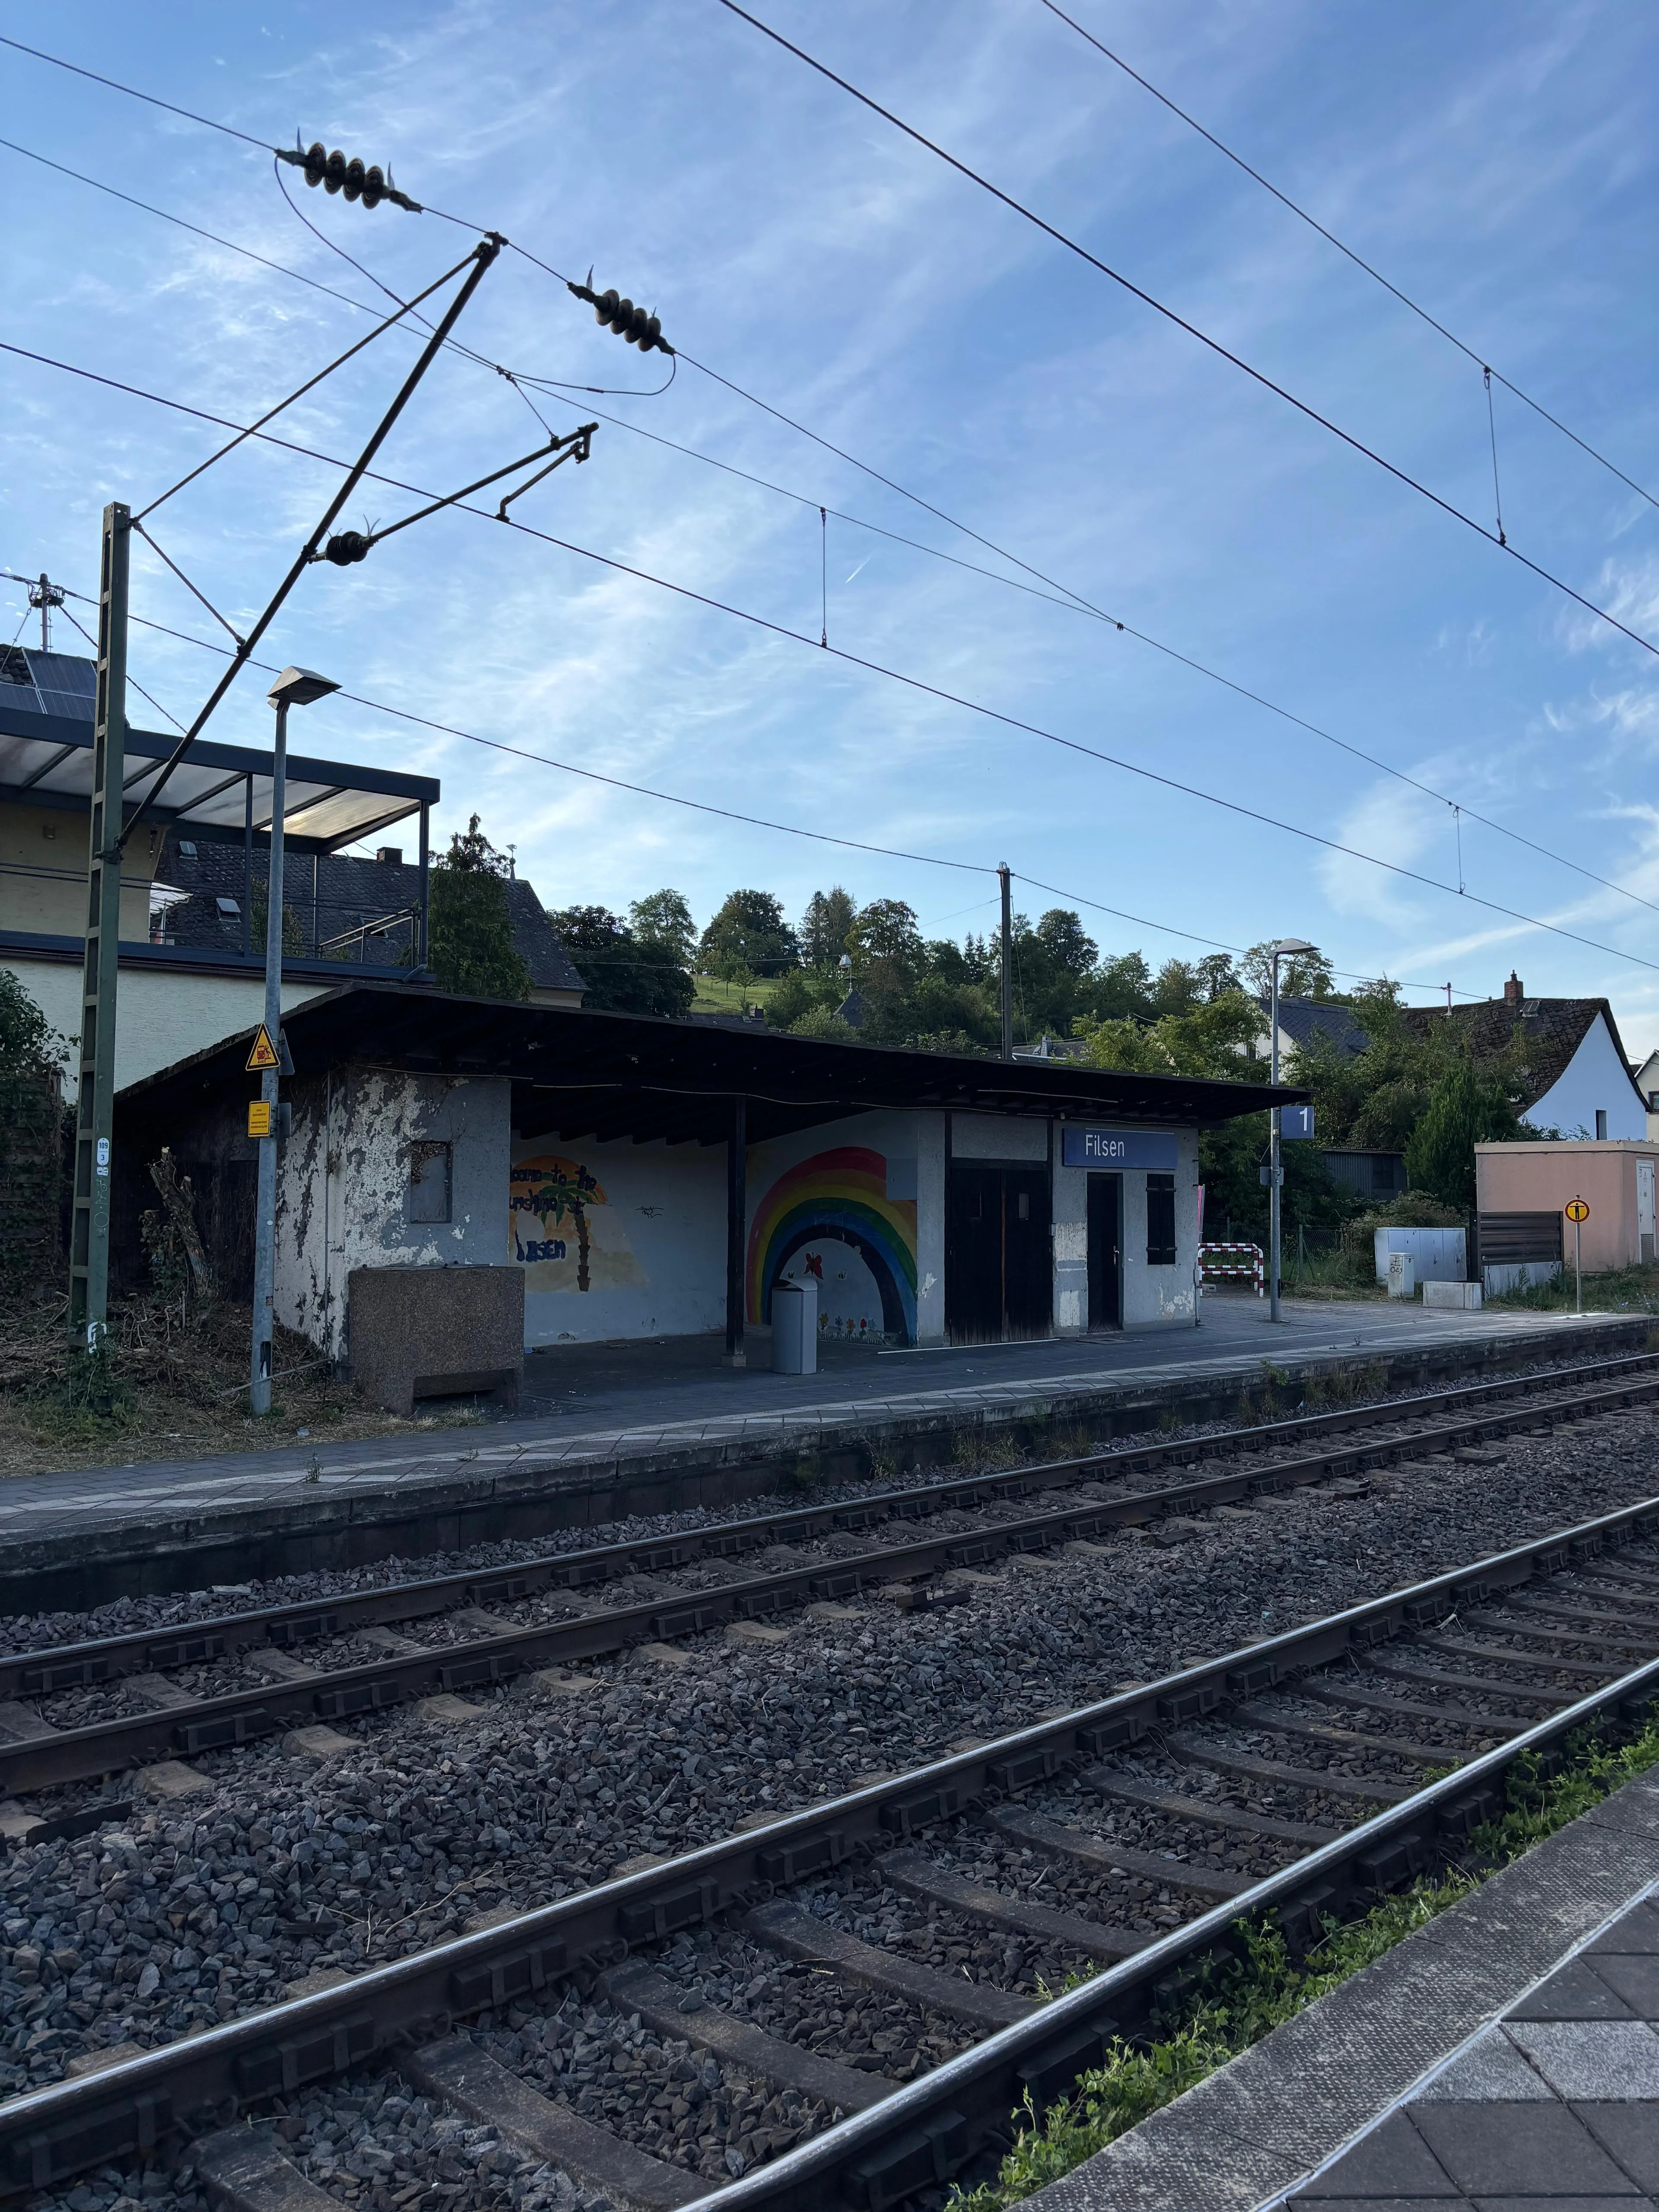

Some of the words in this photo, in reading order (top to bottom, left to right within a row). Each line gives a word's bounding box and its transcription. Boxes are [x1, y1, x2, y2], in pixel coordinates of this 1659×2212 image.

[1299, 1107, 1308, 1131] 1
[1085, 1134, 1125, 1157] Filsen
[551, 1163, 567, 1186] to
[509, 1189, 557, 1216] unshine
